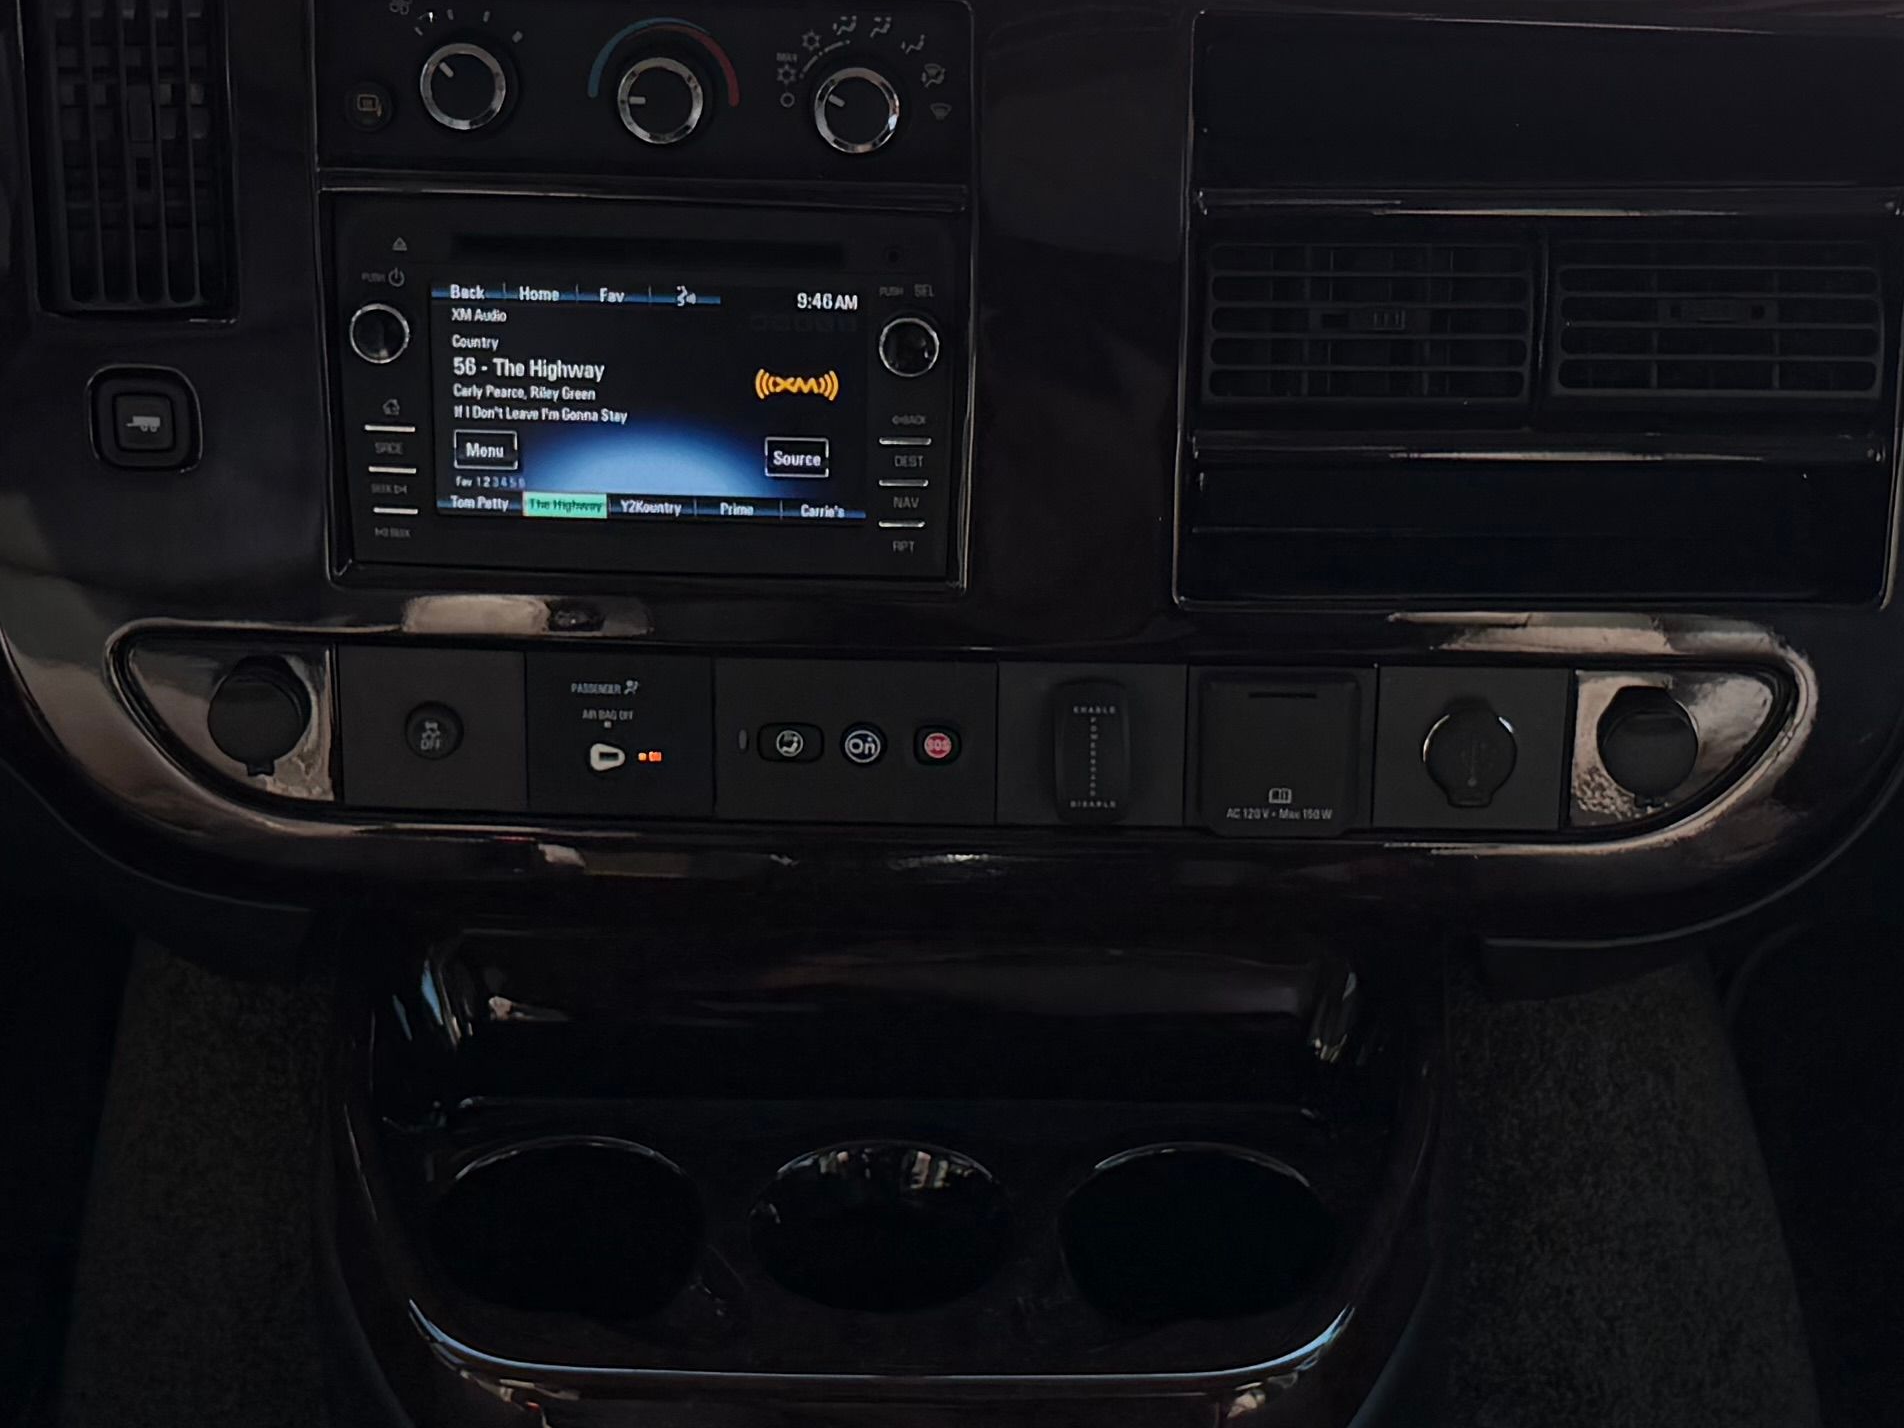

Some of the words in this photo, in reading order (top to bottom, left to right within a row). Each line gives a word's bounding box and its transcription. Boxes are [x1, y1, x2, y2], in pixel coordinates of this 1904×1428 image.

[450, 283, 486, 300] Back
[519, 285, 560, 302] Home
[599, 287, 625, 303] Fav
[451, 308, 472, 322] XM
[474, 308, 507, 323] Audio
[452, 334, 500, 352] Country
[492, 357, 525, 377] The
[529, 359, 606, 383] Highway
[453, 383, 483, 400] Carly
[485, 384, 528, 400] Pearce,
[530, 386, 560, 402] Riley
[561, 387, 596, 401] Green
[472, 405, 504, 420] Don't
[505, 406, 539, 421] Leave
[541, 407, 560, 421] I'm
[561, 408, 598, 422] Gonna
[600, 408, 628, 425] Stay
[465, 441, 505, 458] Menu
[772, 450, 822, 467] Source
[893, 455, 925, 468] DEST
[450, 495, 475, 510] Tom
[476, 495, 510, 512] Petty
[529, 498, 550, 510] The
[551, 498, 603, 513] Highway
[620, 499, 683, 517] Y2Kountry
[719, 501, 755, 517] Prime
[800, 503, 846, 519] Carrie's
[893, 497, 920, 509] NAV
[892, 540, 916, 552] RPT
[570, 682, 622, 695] PASSENGER
[1072, 705, 1116, 714] ENABLE
[1069, 799, 1117, 809] DISABLE
[1226, 807, 1241, 819] AC
[1278, 808, 1301, 820] Max
